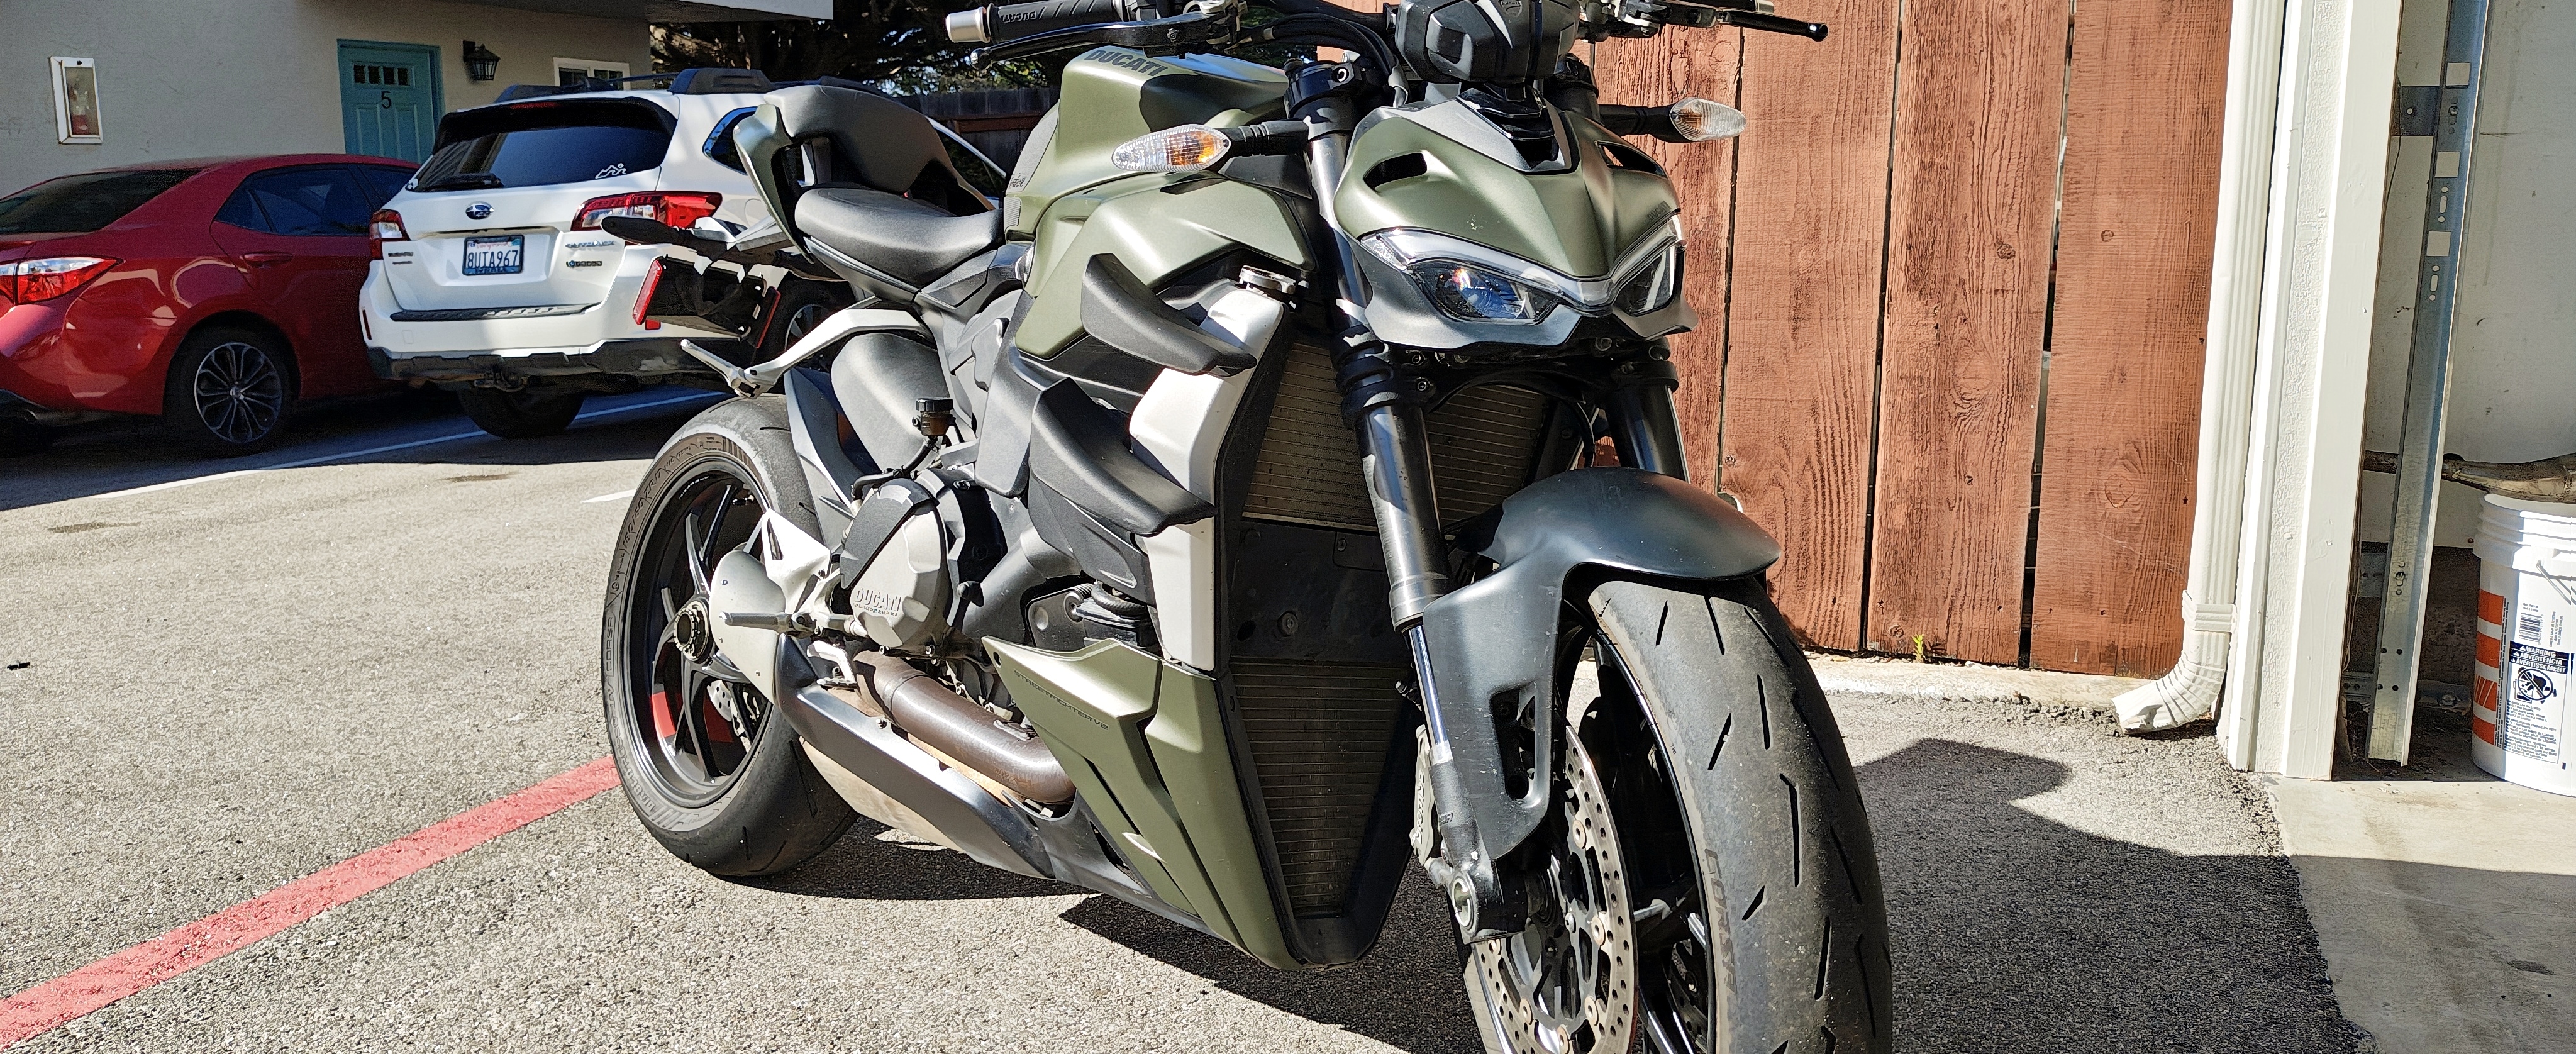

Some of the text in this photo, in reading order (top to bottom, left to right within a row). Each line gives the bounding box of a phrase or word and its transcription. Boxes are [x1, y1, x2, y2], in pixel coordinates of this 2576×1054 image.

[1001, 11, 1037, 23] DUCATI
[1084, 50, 1169, 76] DUCATI
[381, 91, 392, 109] 5
[855, 587, 902, 611] DUCATI
[2520, 652, 2563, 665] ADVERTENCIA
[2526, 645, 2557, 657] WARNING
[2516, 658, 2567, 673] AVERTISSEMENT
[1415, 769, 1425, 844] brembo
